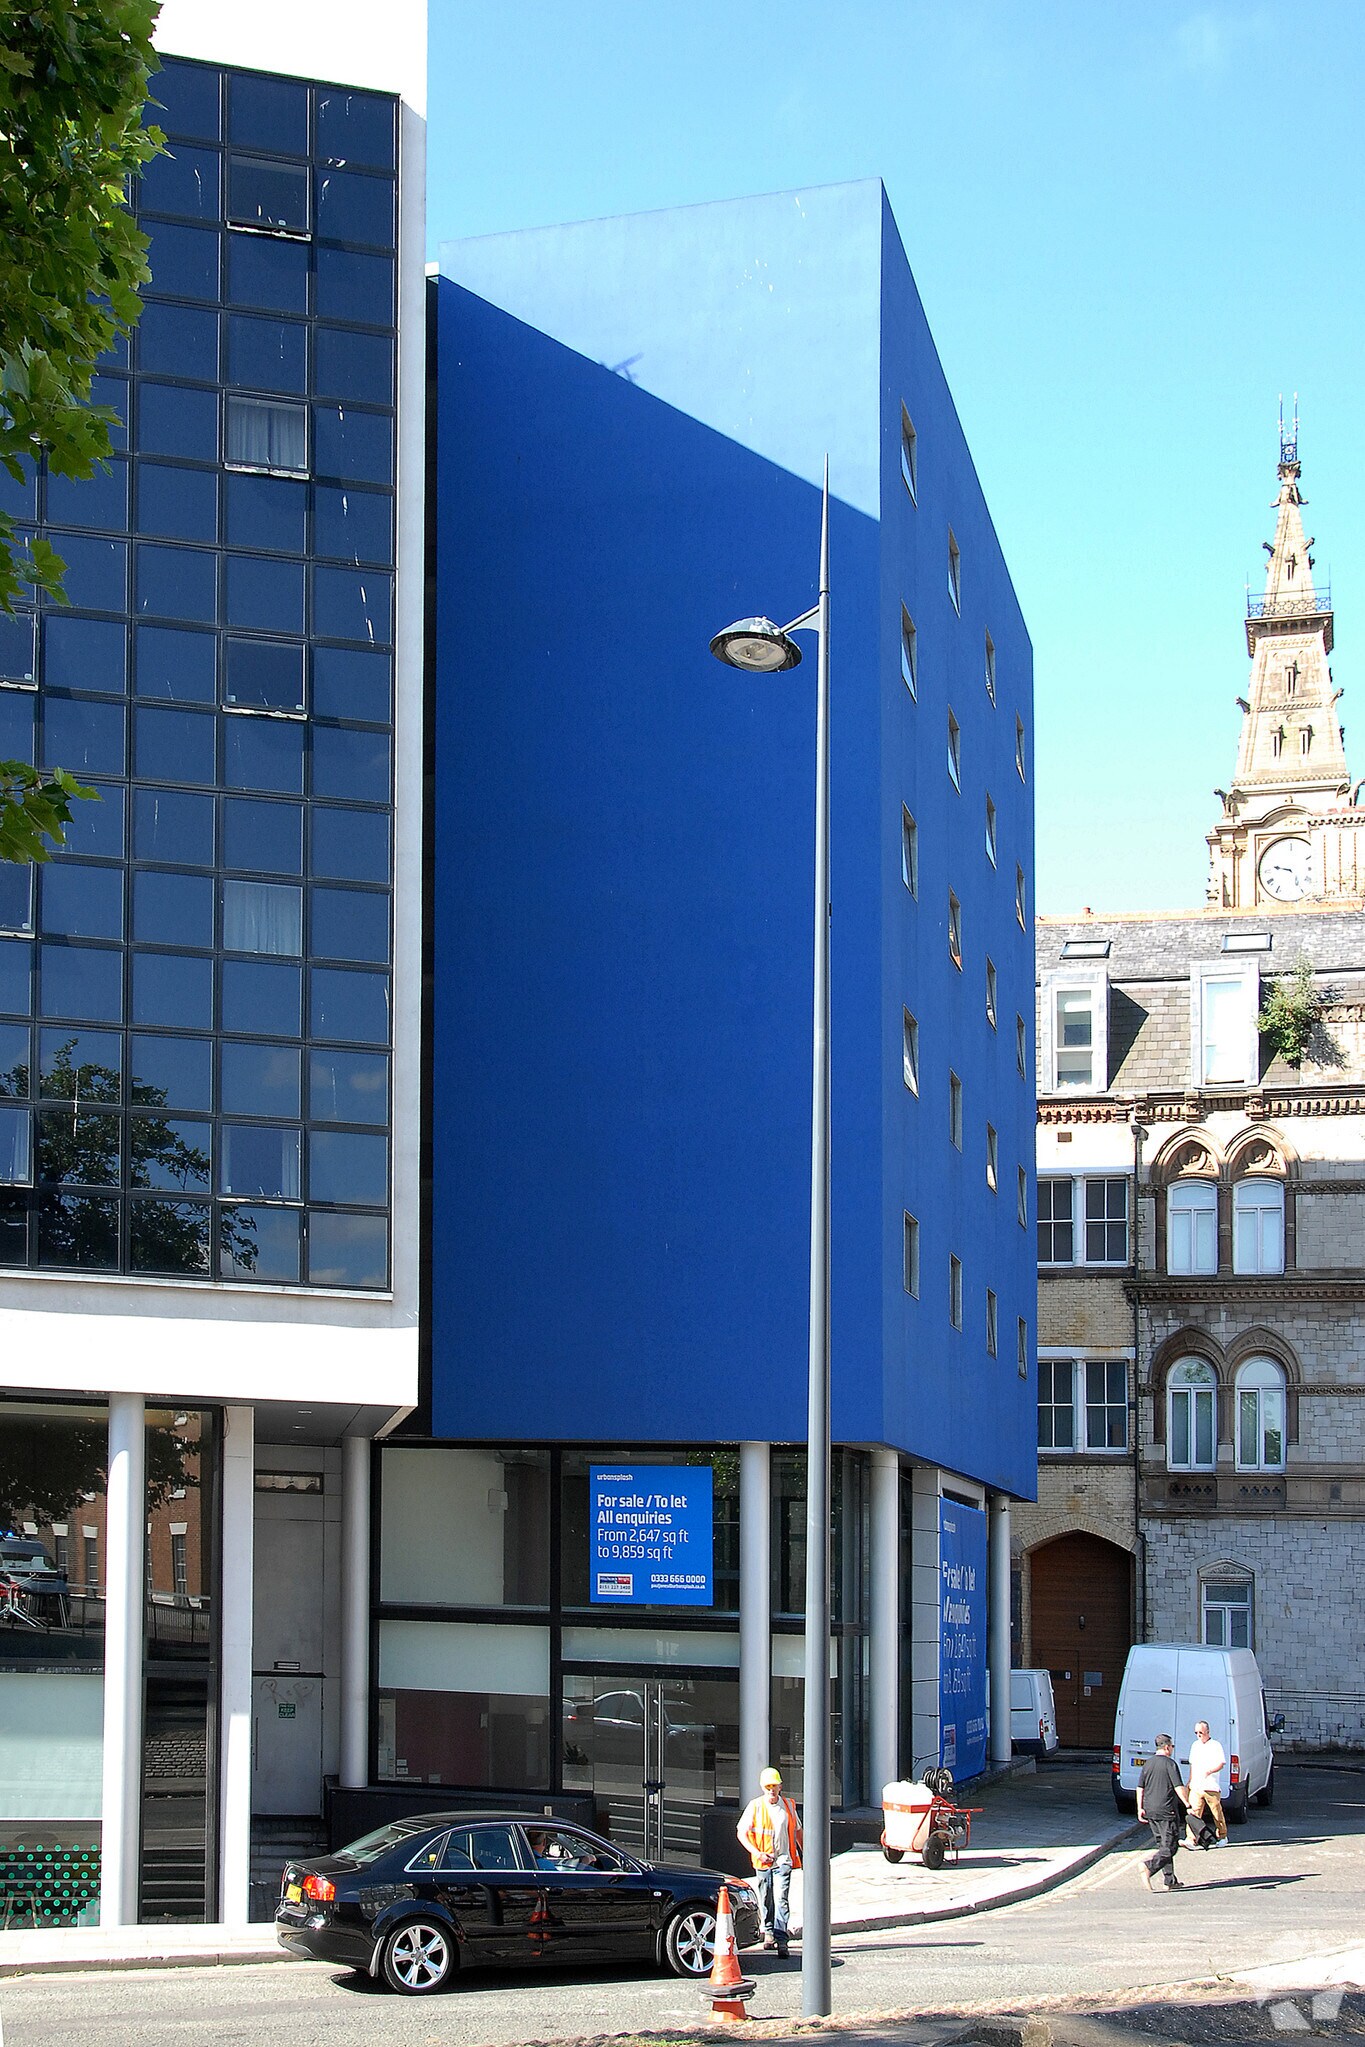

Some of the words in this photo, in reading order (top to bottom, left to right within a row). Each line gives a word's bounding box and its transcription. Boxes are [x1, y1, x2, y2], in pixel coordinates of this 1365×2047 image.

[597, 1474, 633, 1482] urbansplash
[597, 1494, 617, 1507] For
[619, 1494, 644, 1508] sale
[646, 1495, 653, 1508] /
[654, 1495, 668, 1508] To
[670, 1495, 688, 1508] let
[597, 1510, 613, 1524] All
[615, 1511, 672, 1527] enquiries
[597, 1528, 627, 1542] From
[629, 1529, 661, 1543] 2,647
[662, 1531, 677, 1545] sq
[679, 1529, 689, 1543] ft
[597, 1545, 610, 1558] to
[612, 1545, 645, 1560] 9,859
[646, 1547, 661, 1561] sq
[663, 1545, 673, 1560] ft
[650, 1574, 668, 1583] 0333
[669, 1574, 684, 1584] 666
[685, 1575, 706, 1584] 0000
